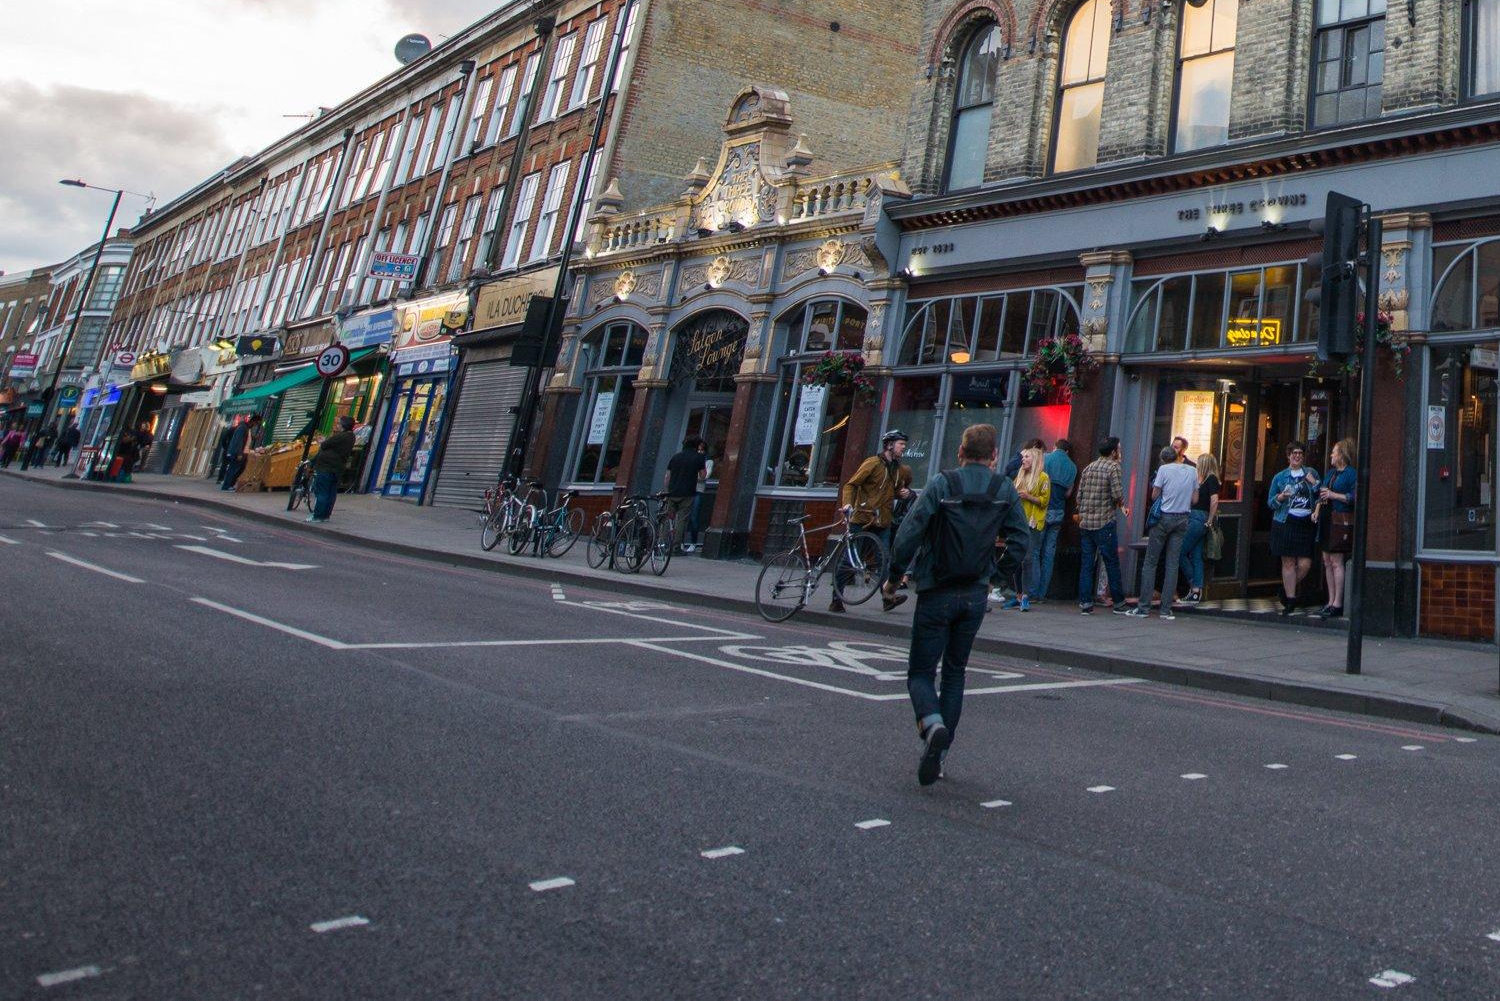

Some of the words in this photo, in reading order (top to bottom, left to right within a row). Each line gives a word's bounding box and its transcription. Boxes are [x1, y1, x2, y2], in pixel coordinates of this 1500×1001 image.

[1177, 207, 1200, 220] THE
[1205, 202, 1244, 216] THREE
[1249, 193, 1306, 212] CROWNS
[375, 253, 388, 262] OFF
[389, 255, 415, 265] LICENCE
[374, 271, 410, 279] OPEN
[321, 353, 341, 366] 30
[696, 340, 738, 371] Lounge
